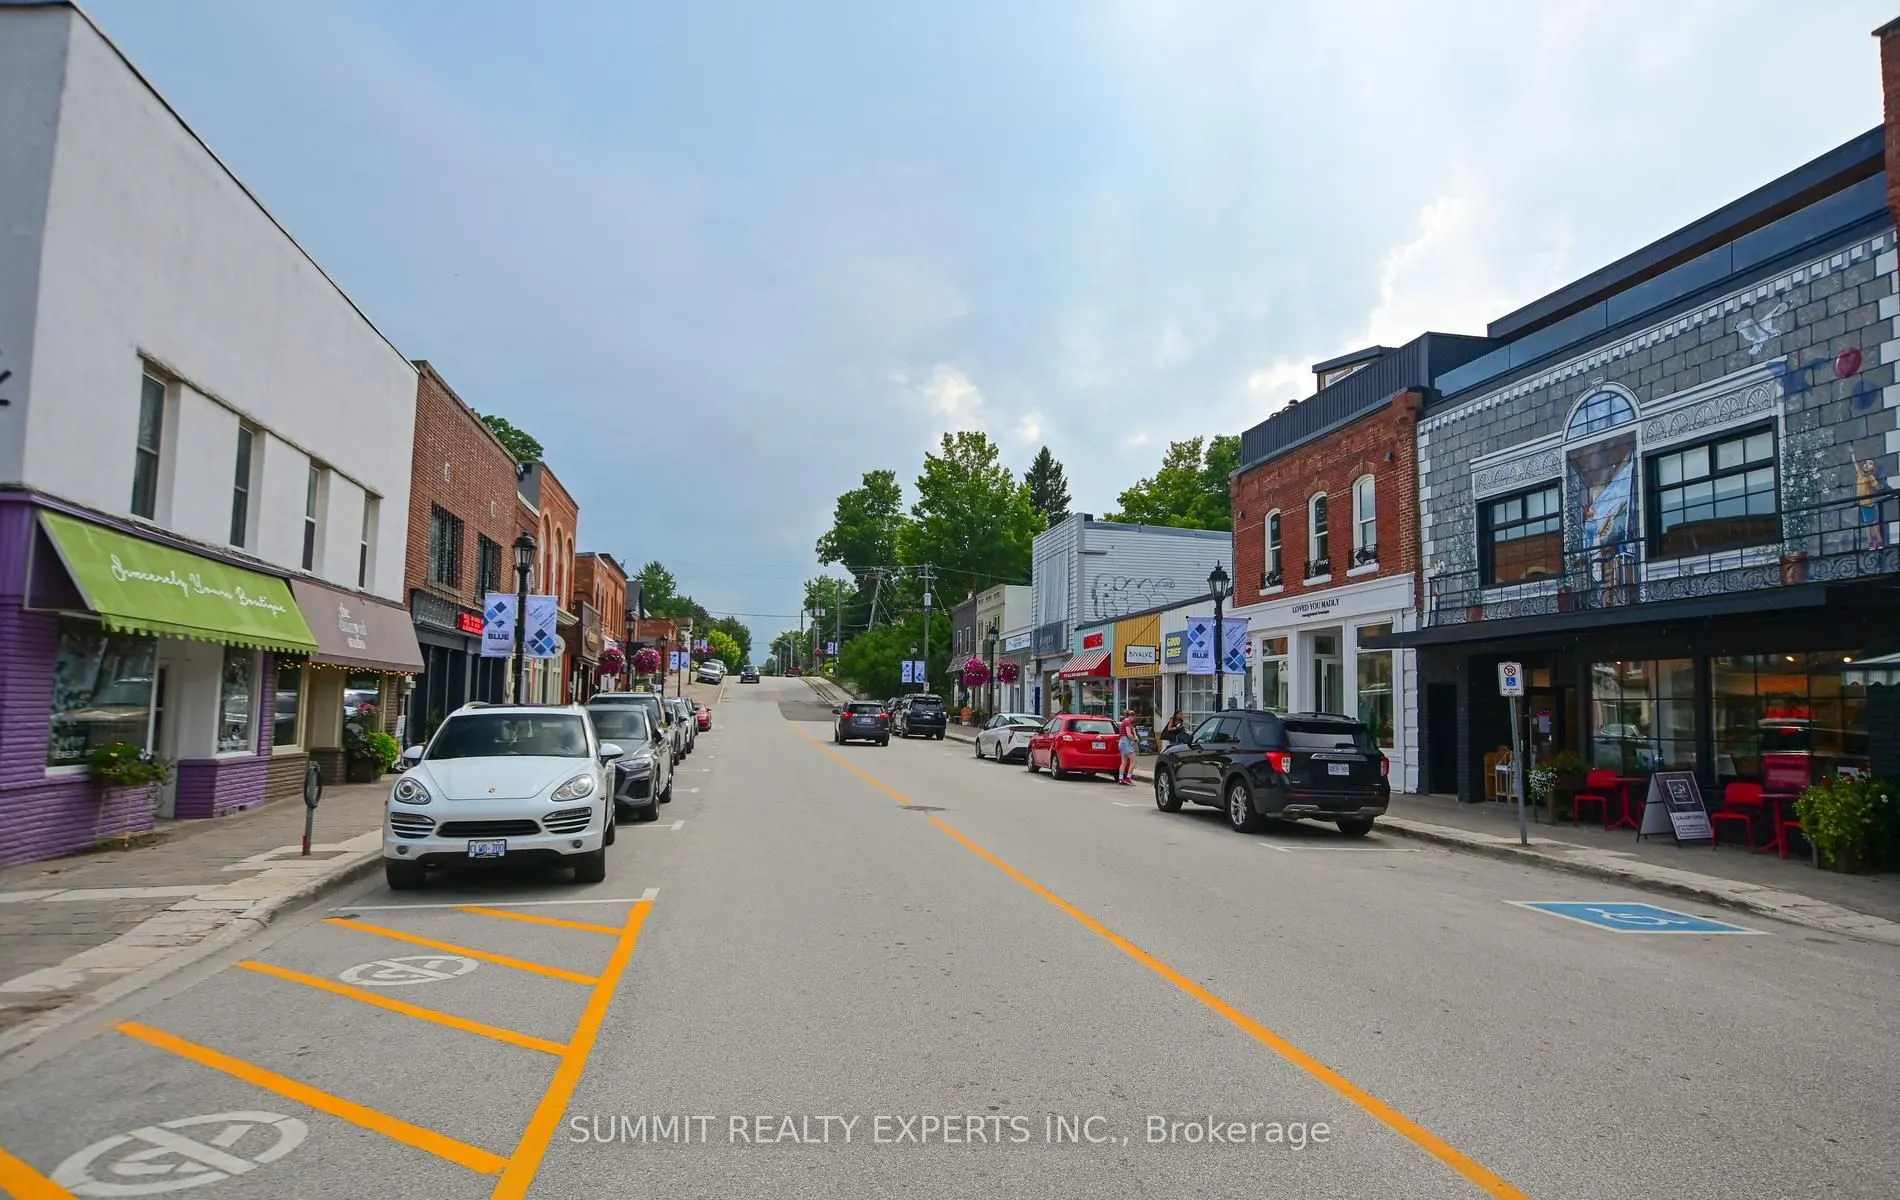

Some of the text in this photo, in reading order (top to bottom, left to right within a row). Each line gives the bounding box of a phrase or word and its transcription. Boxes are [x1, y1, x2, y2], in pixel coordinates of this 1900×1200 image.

[110, 553, 287, 618] Sincerely Yours Boutique
[1292, 598, 1339, 614] LOVED YOU MADLY
[488, 633, 510, 641] BLUE
[1166, 636, 1181, 648] GOOD
